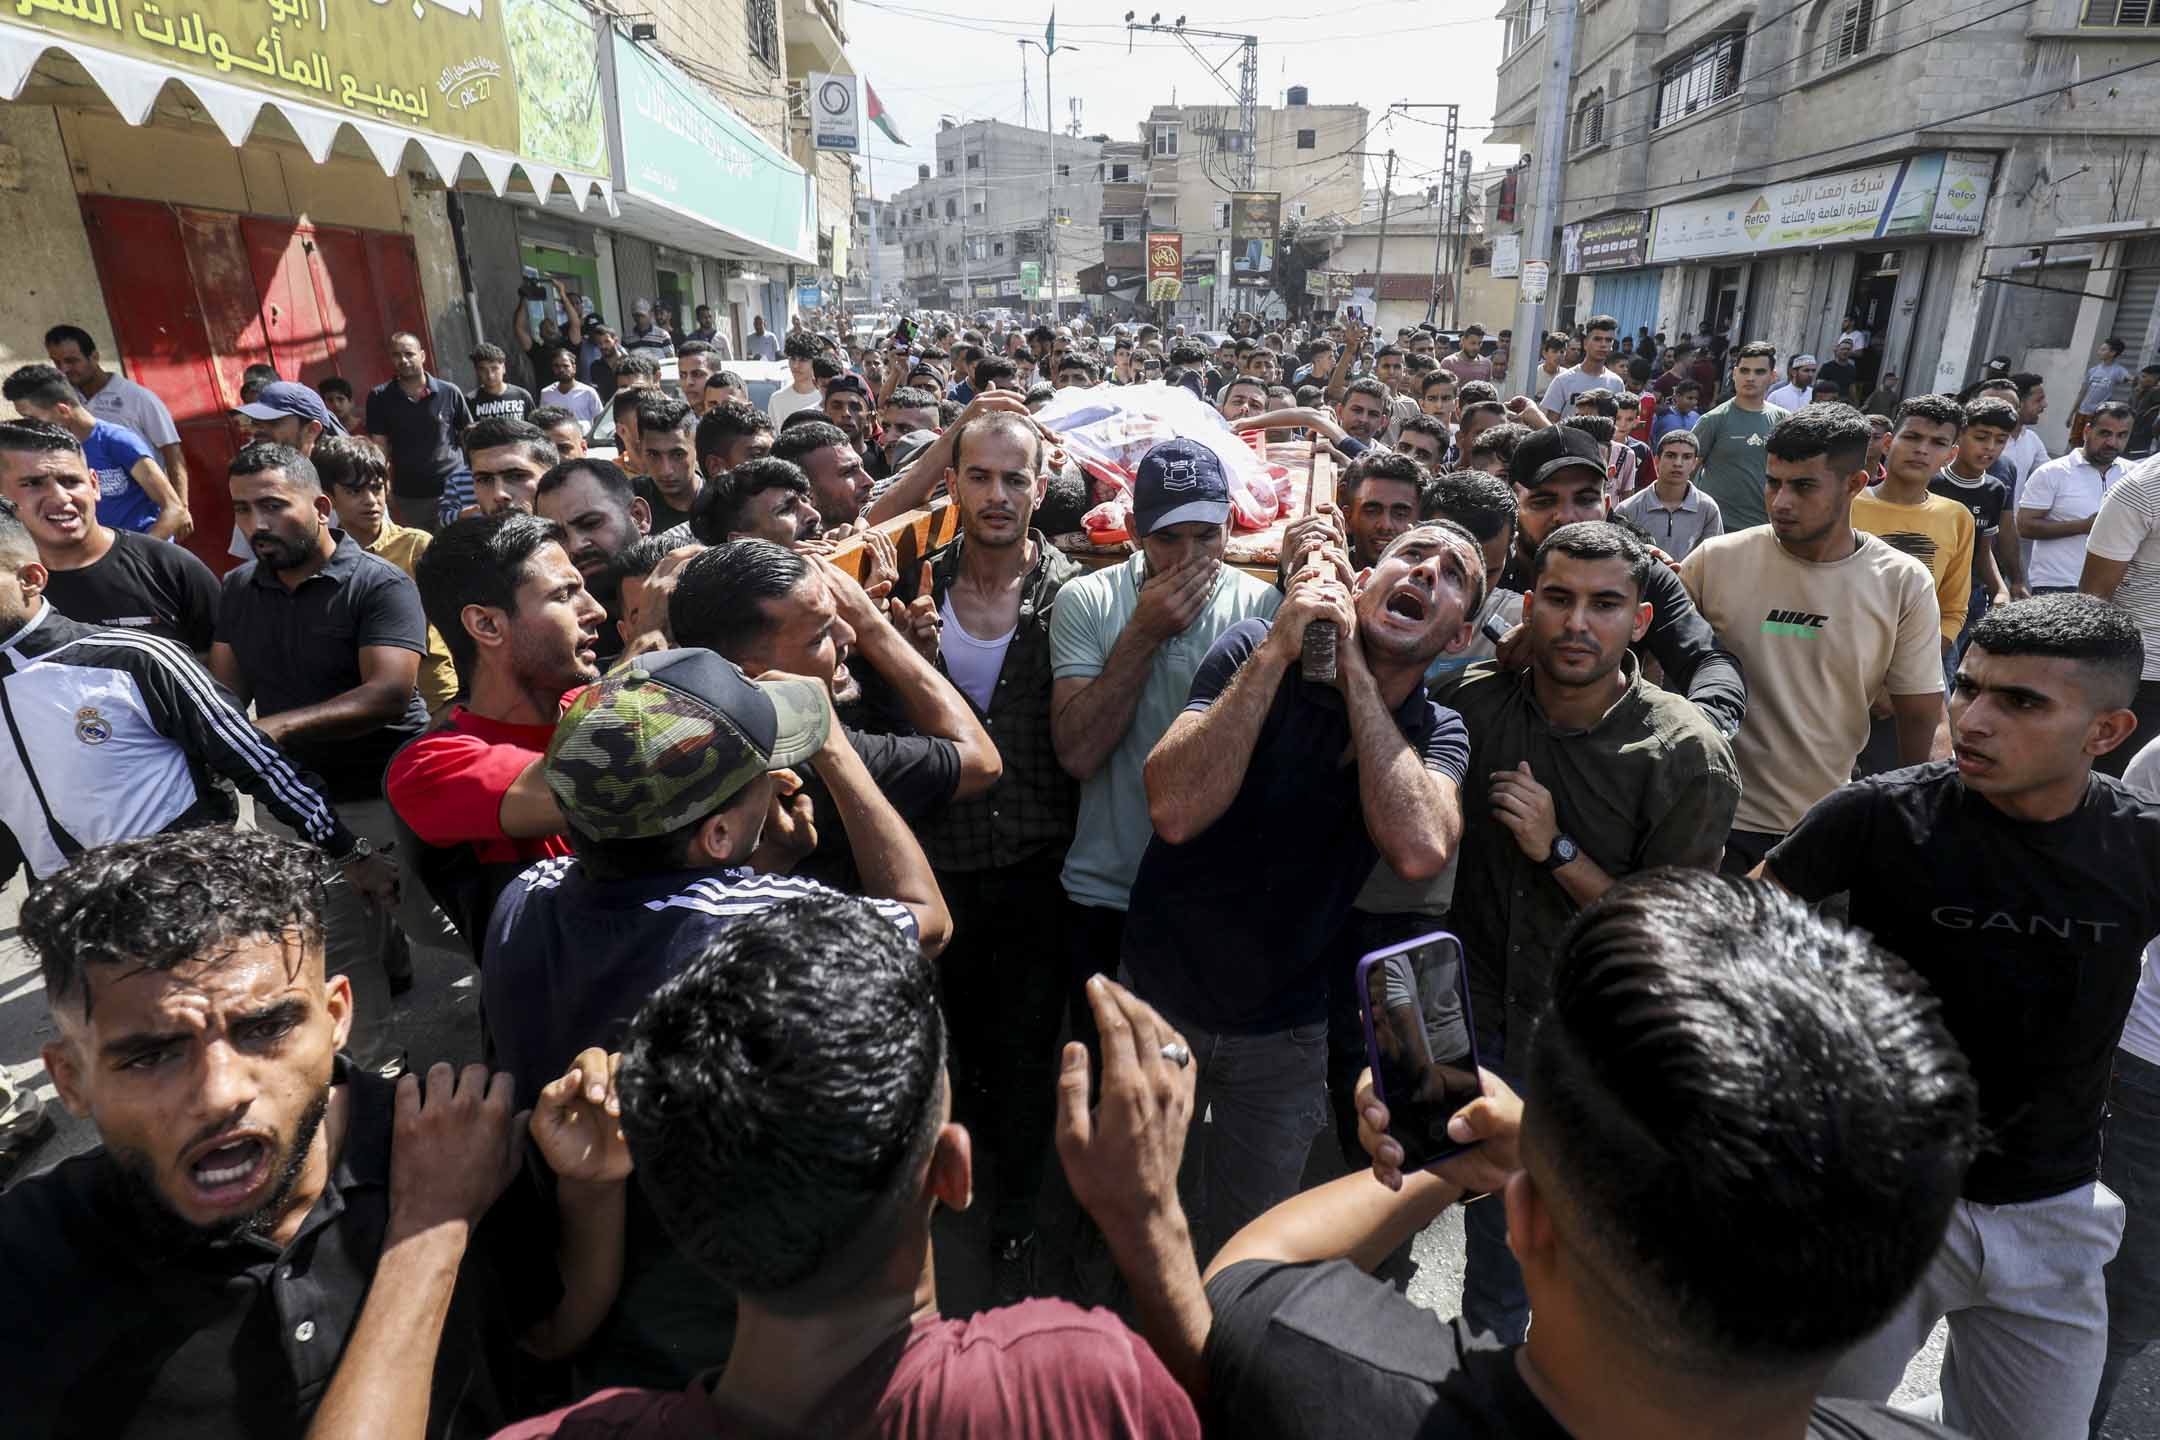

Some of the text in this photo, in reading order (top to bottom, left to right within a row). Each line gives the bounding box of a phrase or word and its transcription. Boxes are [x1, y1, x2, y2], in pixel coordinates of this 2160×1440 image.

[134, 1, 332, 92] المأكولات
[339, 74, 429, 123] لجميع
[1850, 171, 1885, 196] شركة
[1948, 189, 1977, 200] Refco
[1817, 203, 1846, 219] العامة
[1848, 197, 1880, 218] للتجارة
[1744, 214, 1771, 225] Refco
[476, 400, 525, 416] WINNERS
[1766, 609, 1829, 628] NIKE
[1931, 905, 2121, 943] GANT
